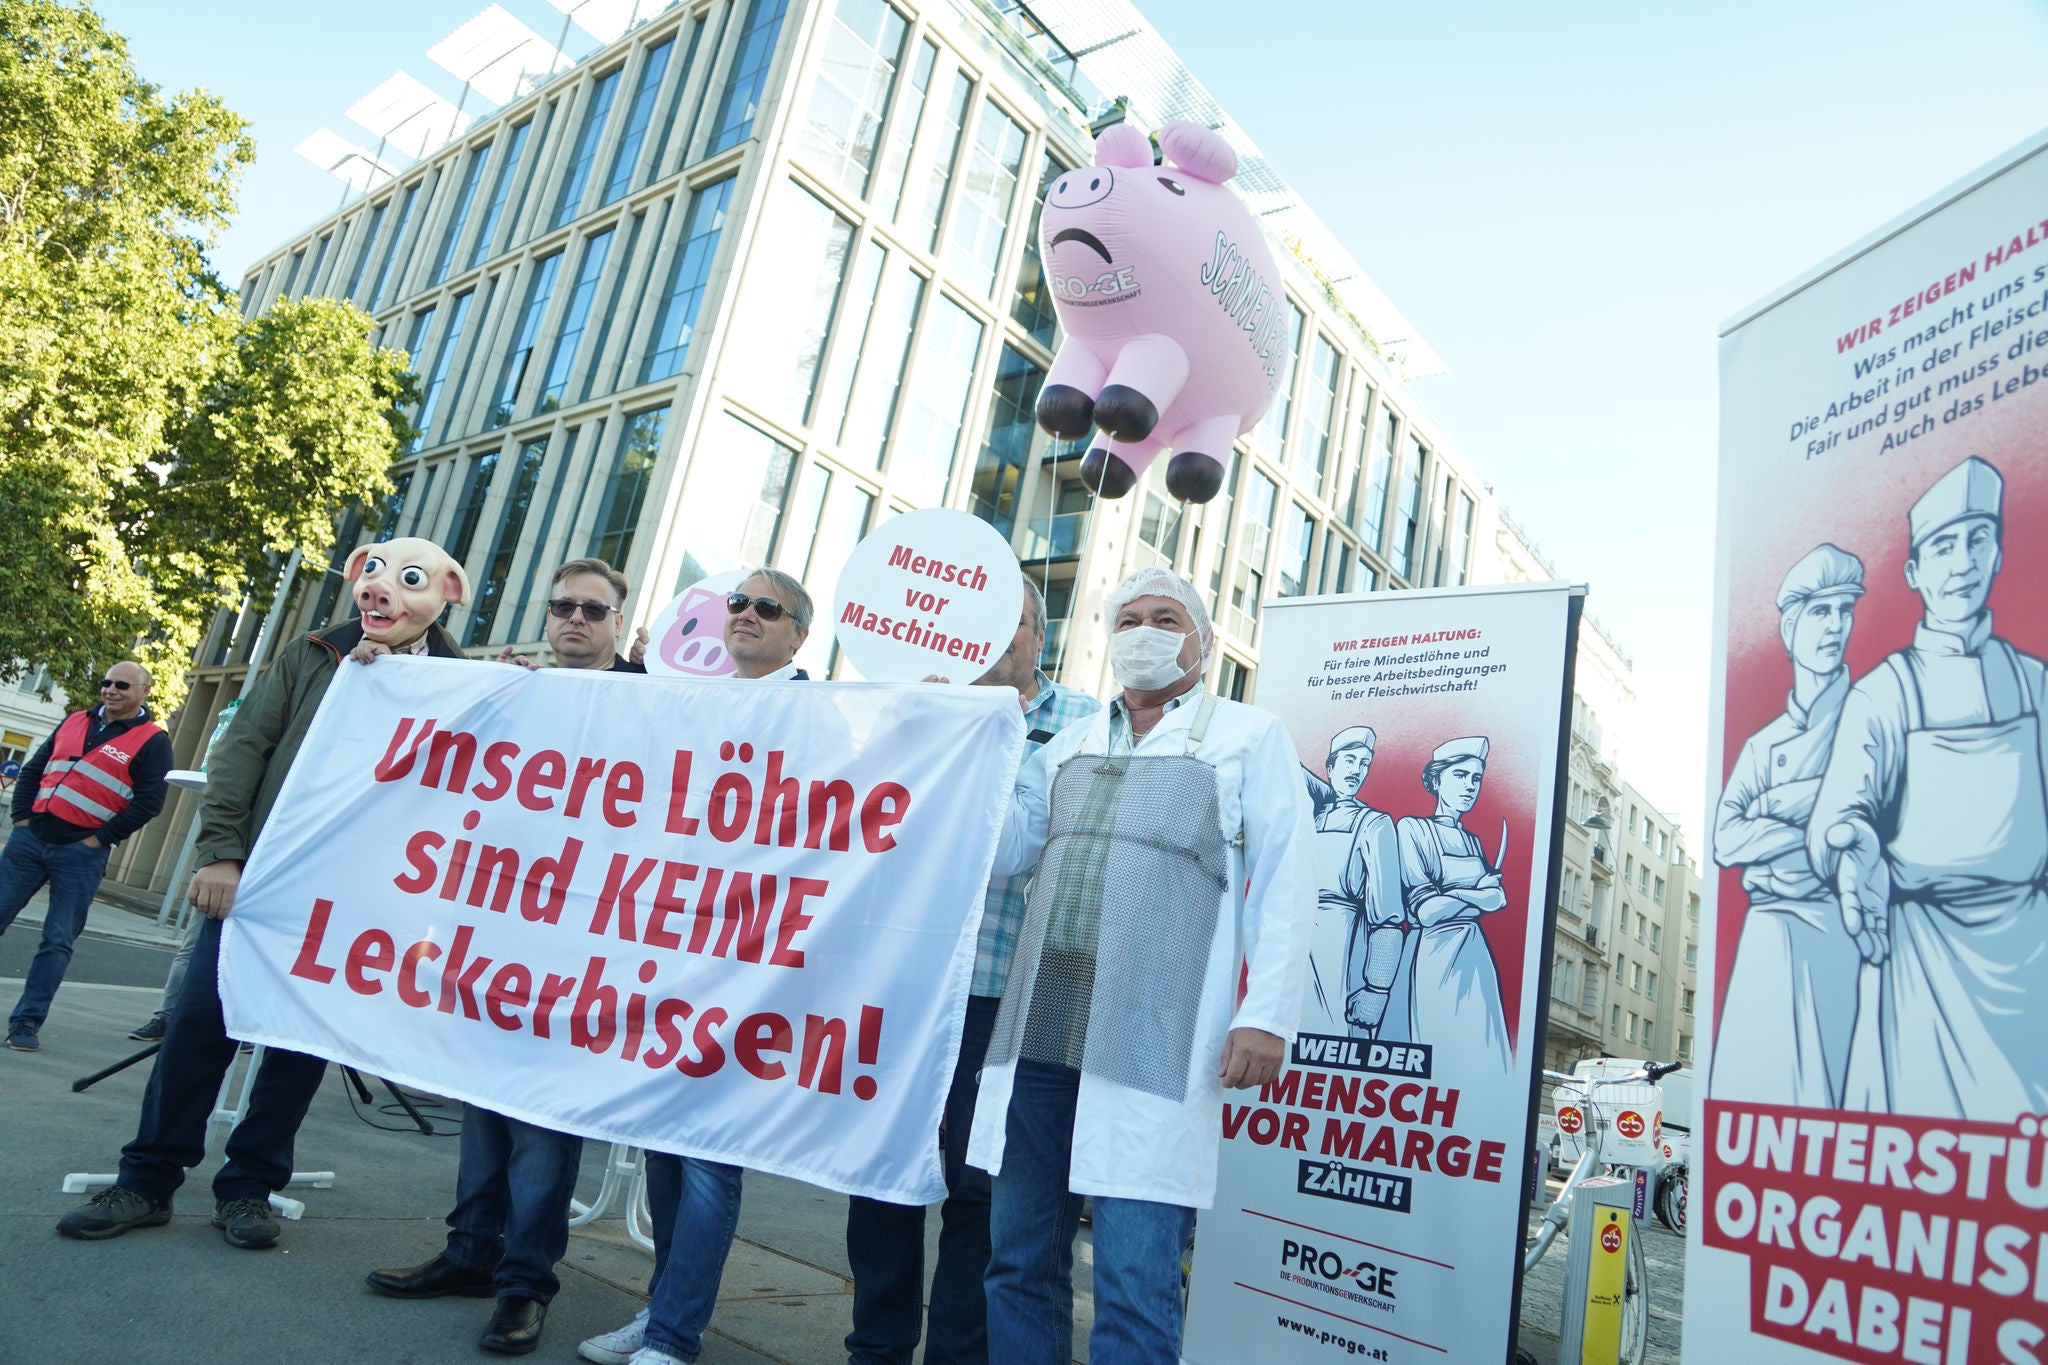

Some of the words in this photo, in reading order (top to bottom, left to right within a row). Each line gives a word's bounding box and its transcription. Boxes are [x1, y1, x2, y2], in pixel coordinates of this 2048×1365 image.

[1836, 318, 1882, 354] WIR
[1888, 262, 1976, 328] ZEIGEN
[1854, 345, 1897, 380] Was
[1903, 302, 1974, 354] macht
[1982, 275, 2025, 311] uns
[2033, 263, 2048, 283] s
[1790, 416, 1819, 442] Die
[1824, 378, 1890, 424] Arbeit
[1895, 364, 1915, 387] in
[1922, 341, 1963, 372] der
[1806, 432, 1841, 460] Fair
[1847, 405, 1888, 440] und
[1893, 386, 1931, 423] gut
[1938, 354, 1999, 396] muss
[1879, 414, 1935, 456] Auch
[1942, 392, 1984, 425] das
[888, 544, 988, 591] Mensch
[840, 601, 992, 665] Maschinen!
[905, 588, 950, 615] vor
[1324, 660, 1342, 671] Für
[1344, 658, 1371, 670] faire
[1373, 650, 1460, 667] Mindestlöhne
[1463, 646, 1490, 659] und
[1332, 641, 1357, 652] WIR
[1360, 635, 1408, 650] ZEIGEN
[1411, 628, 1482, 645] HALTUNG:
[1307, 676, 1324, 688] für
[1326, 673, 1371, 686] bessere
[1373, 662, 1507, 682] Arbeitsbedingungen
[1331, 689, 1342, 700] in
[1345, 687, 1365, 699] der
[1367, 679, 1478, 698] Fleischwirtschaft!
[373, 717, 645, 828] Unsere
[664, 740, 912, 854] Löhne
[393, 809, 584, 925] sind
[588, 852, 829, 969] KEINE
[289, 898, 884, 1101] Leckerbissen!
[1299, 1037, 1361, 1066] WEIL
[1367, 1045, 1426, 1072] DER
[1259, 1069, 1460, 1128] MENSCH
[1222, 1103, 1310, 1151] VOR
[1320, 1118, 1506, 1183] MARGE
[1715, 1111, 2048, 1210] UNTERSTÜ
[1304, 1161, 1404, 1206] ZÄHLT!
[1280, 1270, 1291, 1281] DIE
[1292, 1275, 1396, 1314] PRODUKTIONSGEWERKSCHAFT
[1764, 1264, 1973, 1365] DABEI
[1278, 1316, 1388, 1362] www.proge.at
